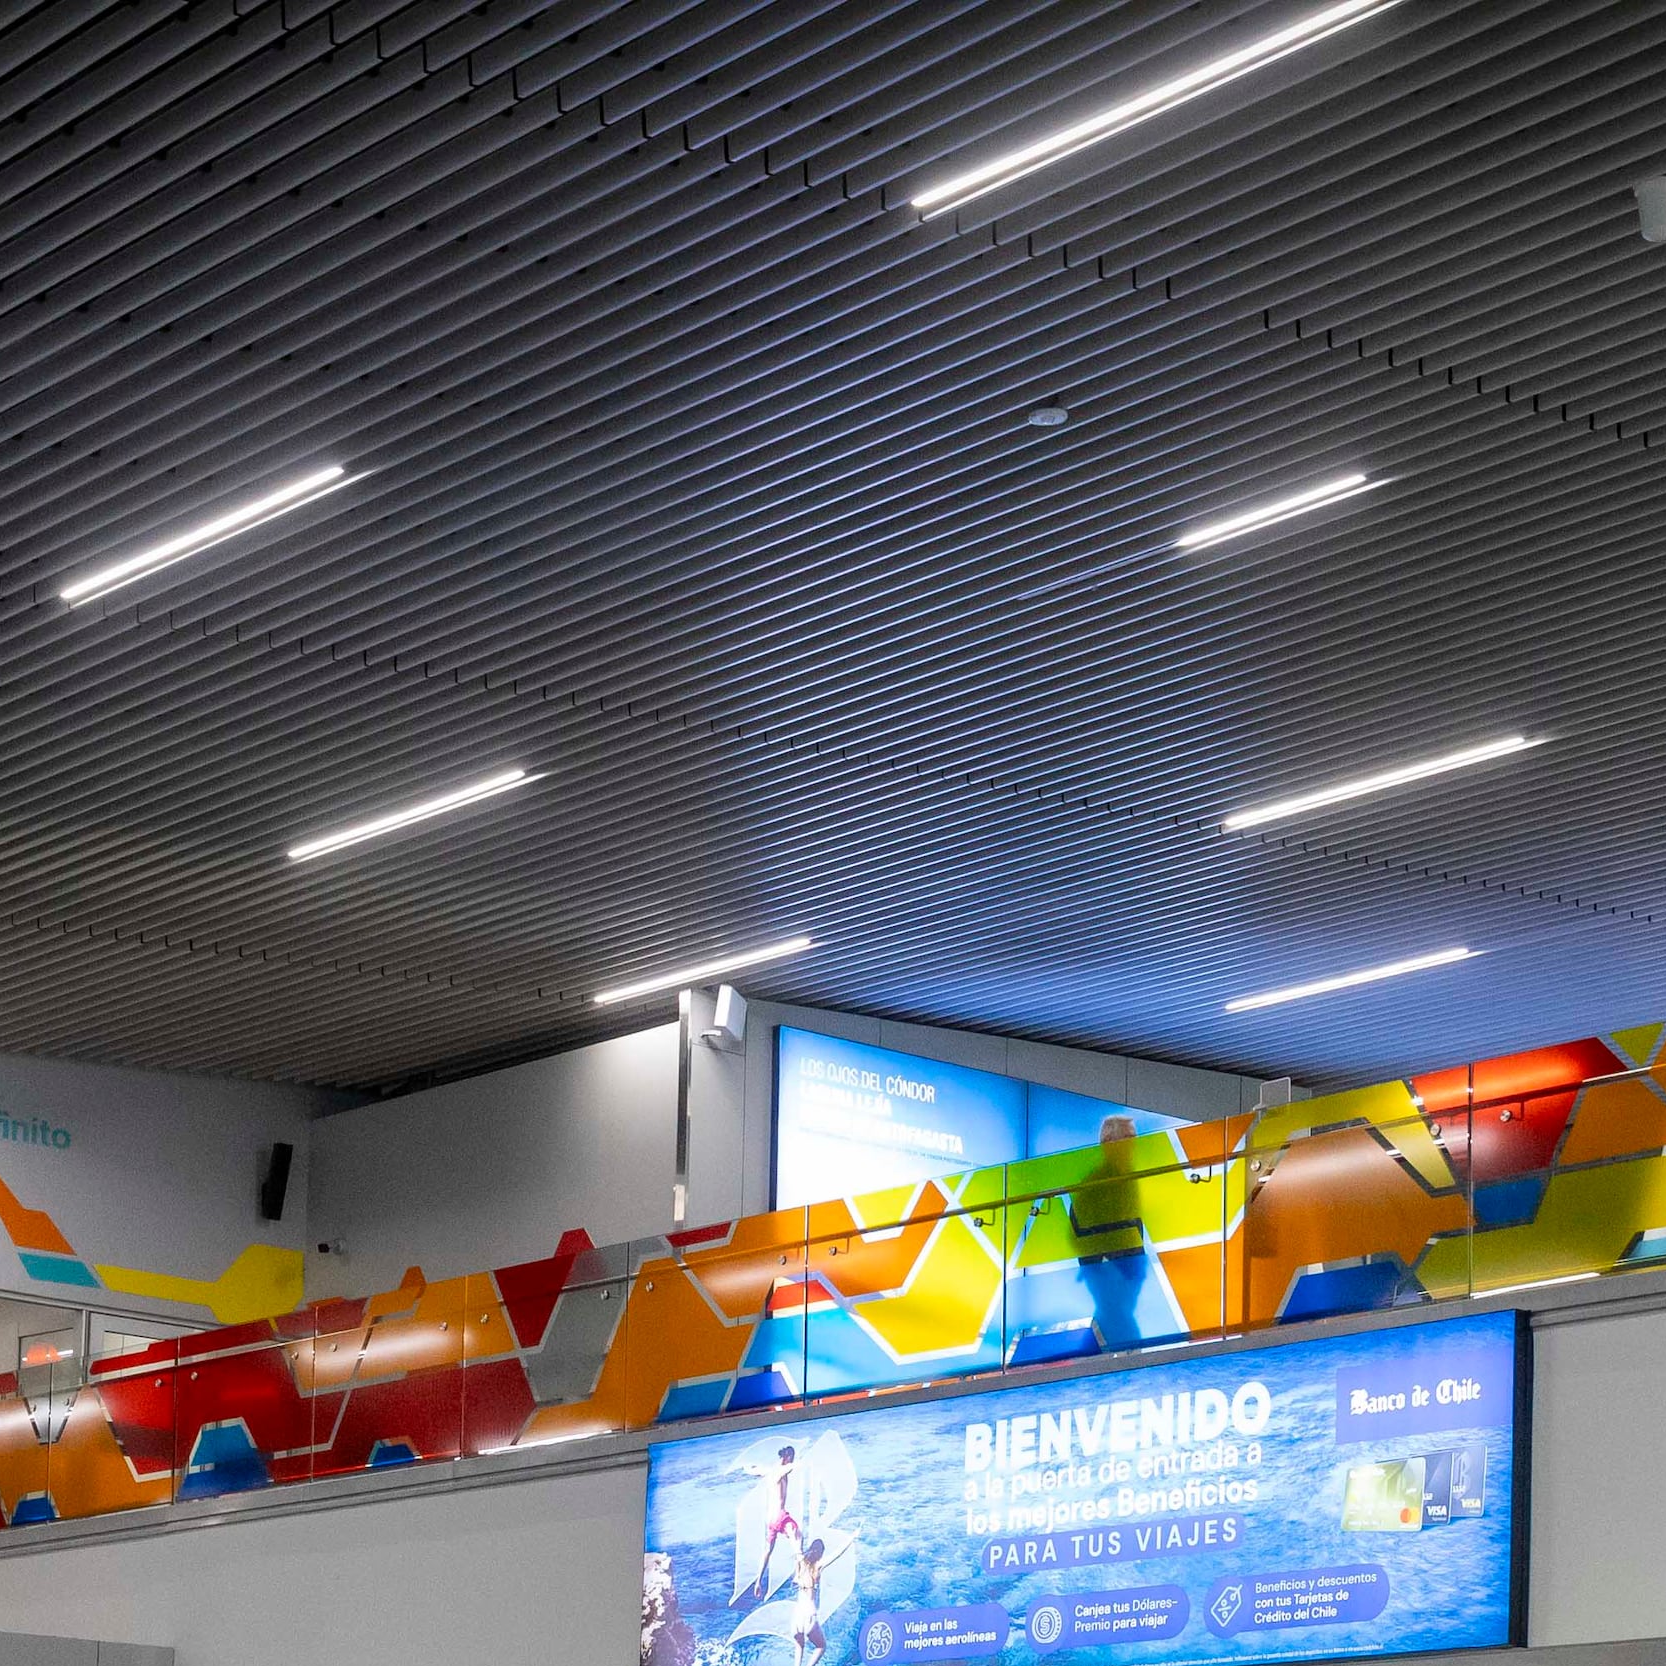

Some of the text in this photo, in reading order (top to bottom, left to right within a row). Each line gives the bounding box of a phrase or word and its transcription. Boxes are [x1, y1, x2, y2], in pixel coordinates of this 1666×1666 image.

[827, 1061, 859, 1087] OJOS
[861, 1070, 882, 1092] DEL
[885, 1075, 935, 1104] CÓNDOR
[1350, 1378, 1482, 1416] Banco de Chile
[964, 1381, 1271, 1474] BIENVENIDO
[964, 1441, 1262, 1502] a la puerta de entrada a
[965, 1478, 1259, 1536] los mejores Beneficios
[989, 1516, 1238, 1569] PARA TUS VIAJES
[1255, 1572, 1377, 1594] Beneficios y descuentos
[1255, 1588, 1349, 1609] con tus Tarjetas de
[1075, 1602, 1111, 1619] Canjea
[1113, 1601, 1131, 1614] tus
[1254, 1605, 1338, 1625] Crédito del Chile
[904, 1617, 958, 1636] Viaja en las
[1074, 1613, 1168, 1633] Premio para viajar
[904, 1629, 997, 1650] mejores aerolíneas
